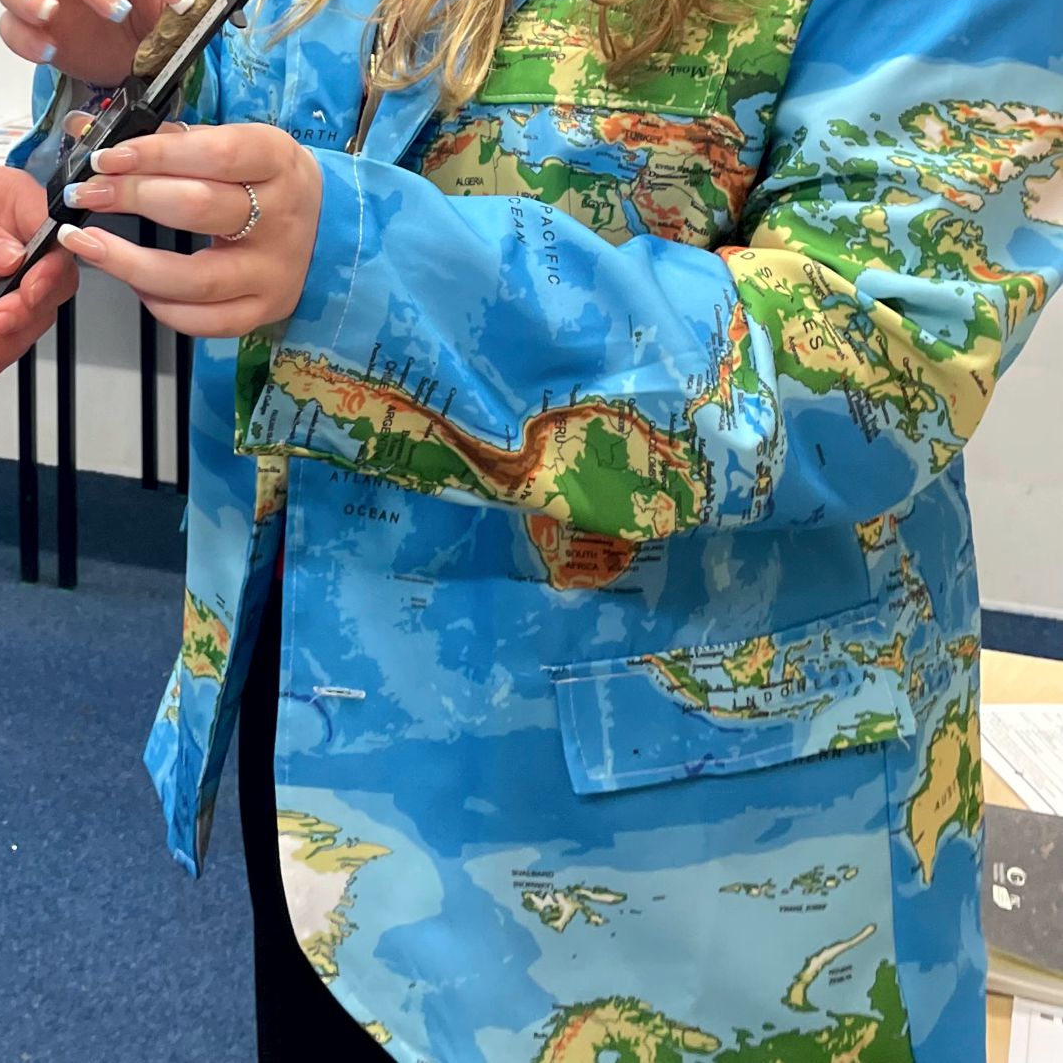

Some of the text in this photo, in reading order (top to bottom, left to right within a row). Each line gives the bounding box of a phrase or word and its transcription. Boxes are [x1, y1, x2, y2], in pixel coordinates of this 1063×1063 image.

[285, 128, 338, 142] ORTH
[456, 177, 484, 186] ALGERIA
[539, 205, 561, 286] PACIFIC
[343, 502, 401, 524] OCEAN
